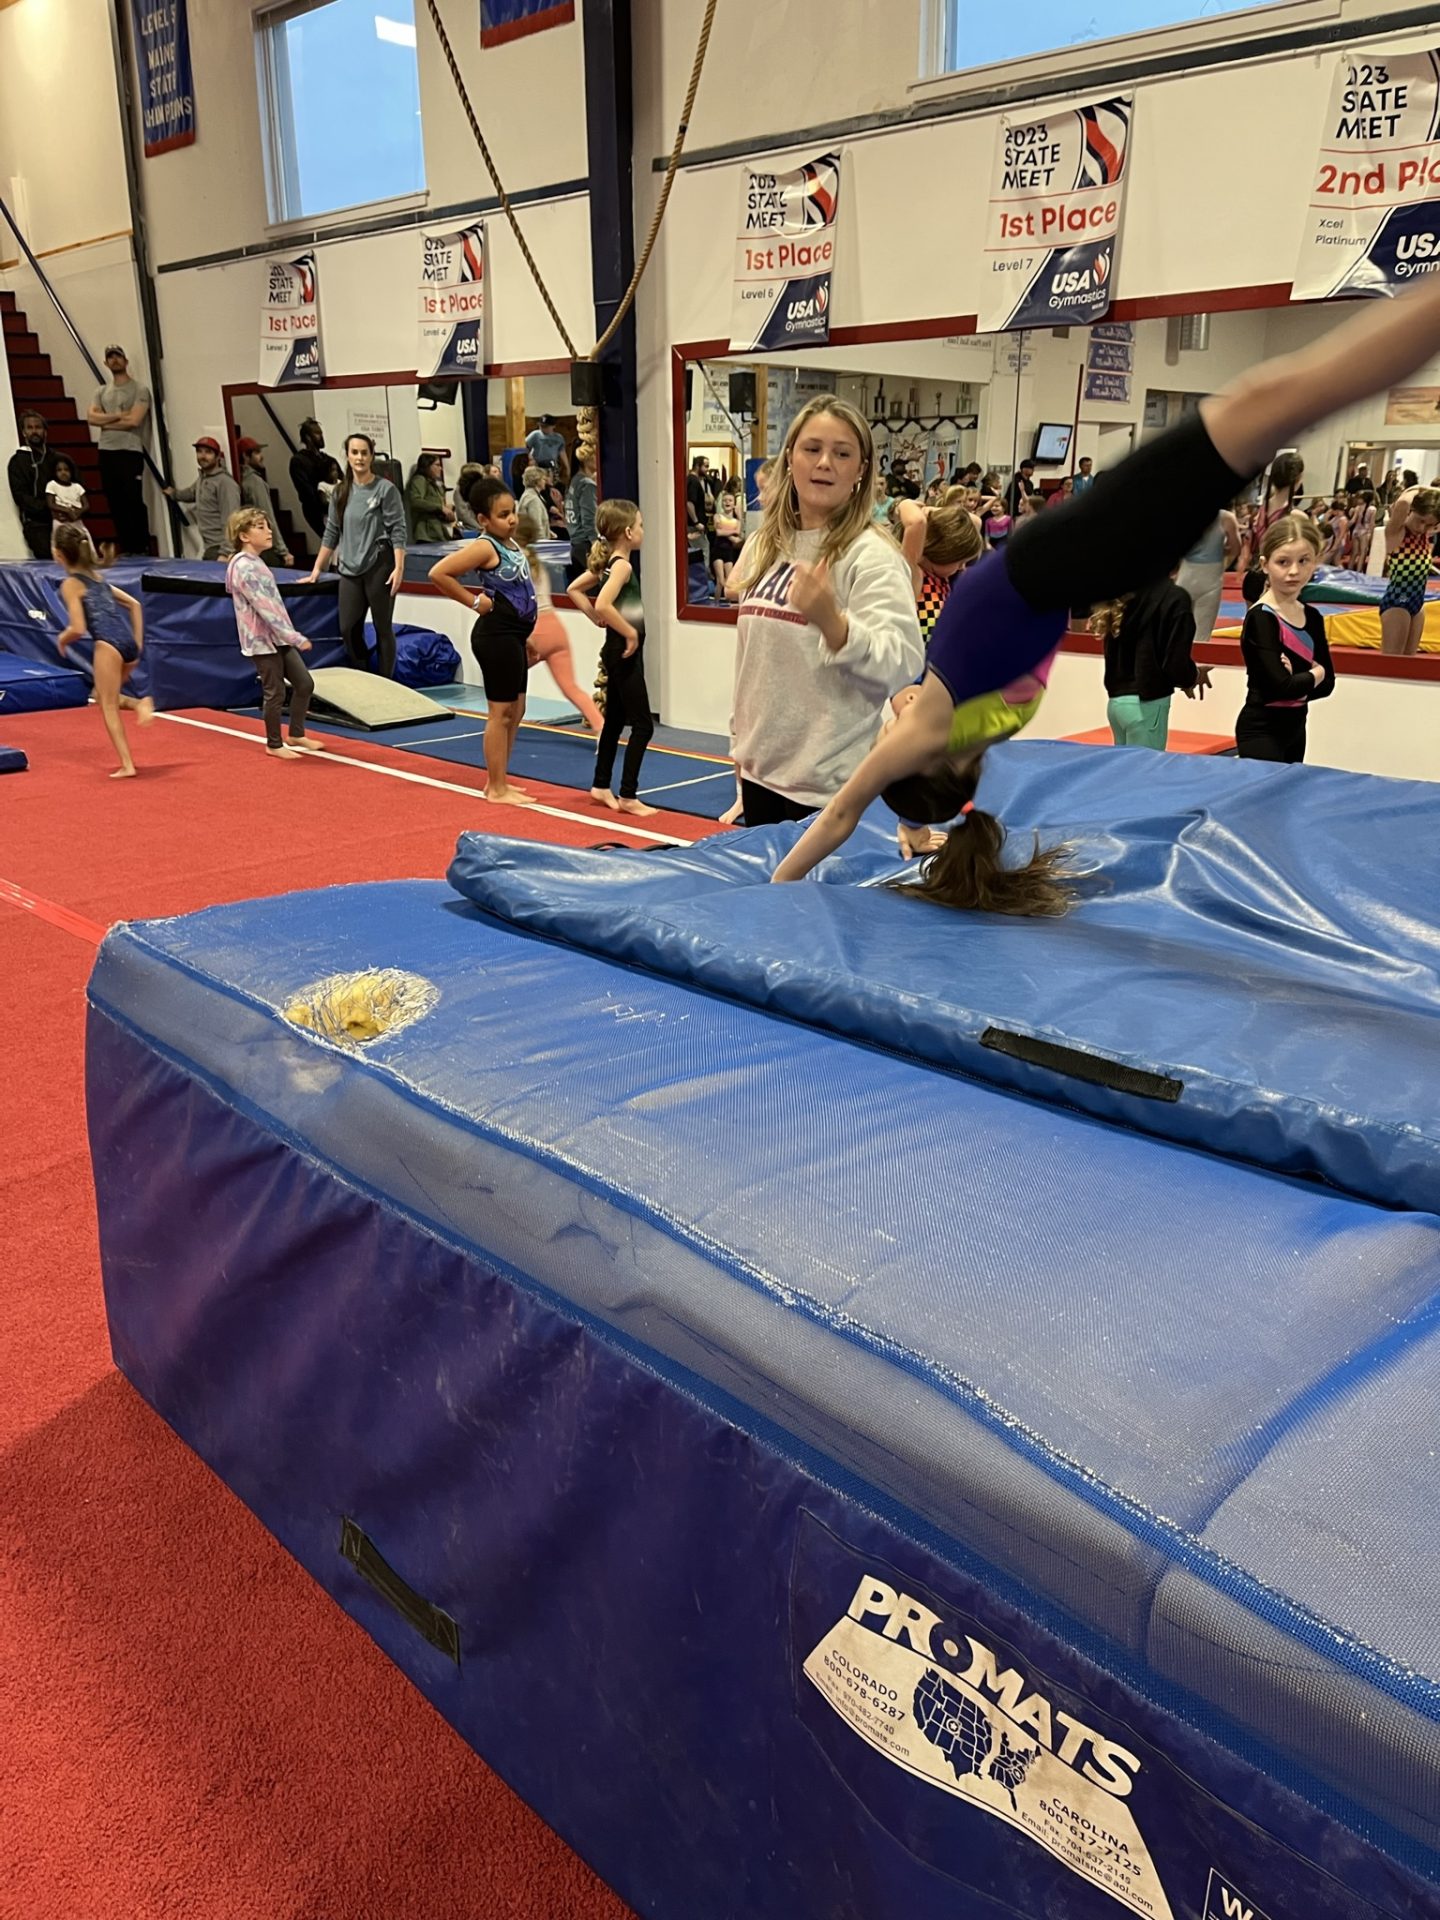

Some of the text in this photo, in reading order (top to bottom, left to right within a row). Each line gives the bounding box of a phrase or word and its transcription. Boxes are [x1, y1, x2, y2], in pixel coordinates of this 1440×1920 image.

[1342, 85, 1408, 113] SATE
[1005, 124, 1048, 147] 2023
[1004, 143, 1061, 167] STATE
[1002, 168, 1055, 190] MEET
[1316, 162, 1385, 195] 2nd
[746, 211, 786, 229] MEET
[999, 201, 1117, 238] 1st Place
[1319, 218, 1344, 229] Xcel
[1315, 234, 1367, 245] Platinum
[746, 241, 832, 270] 1st Place
[992, 258, 1033, 272] Level 7
[1051, 270, 1090, 294] USA
[424, 293, 482, 315] 1st Place
[742, 288, 774, 299] Level 6
[1048, 288, 1106, 309] Gymnastics
[787, 299, 814, 320] USA
[269, 316, 287, 331] 1st
[424, 328, 439, 336] Level
[457, 338, 477, 354] USA
[295, 353, 310, 367] USA
[832, 1650, 898, 1701] COLORADO
[847, 1574, 1141, 1796] PROMATS
[824, 1655, 905, 1721] 800-678-6287
[1052, 1798, 1129, 1855] CAROLINA
[1039, 1800, 1142, 1876] 800-617-7125
[1021, 1811, 1154, 1911] Email: promatsnc@aol.com
